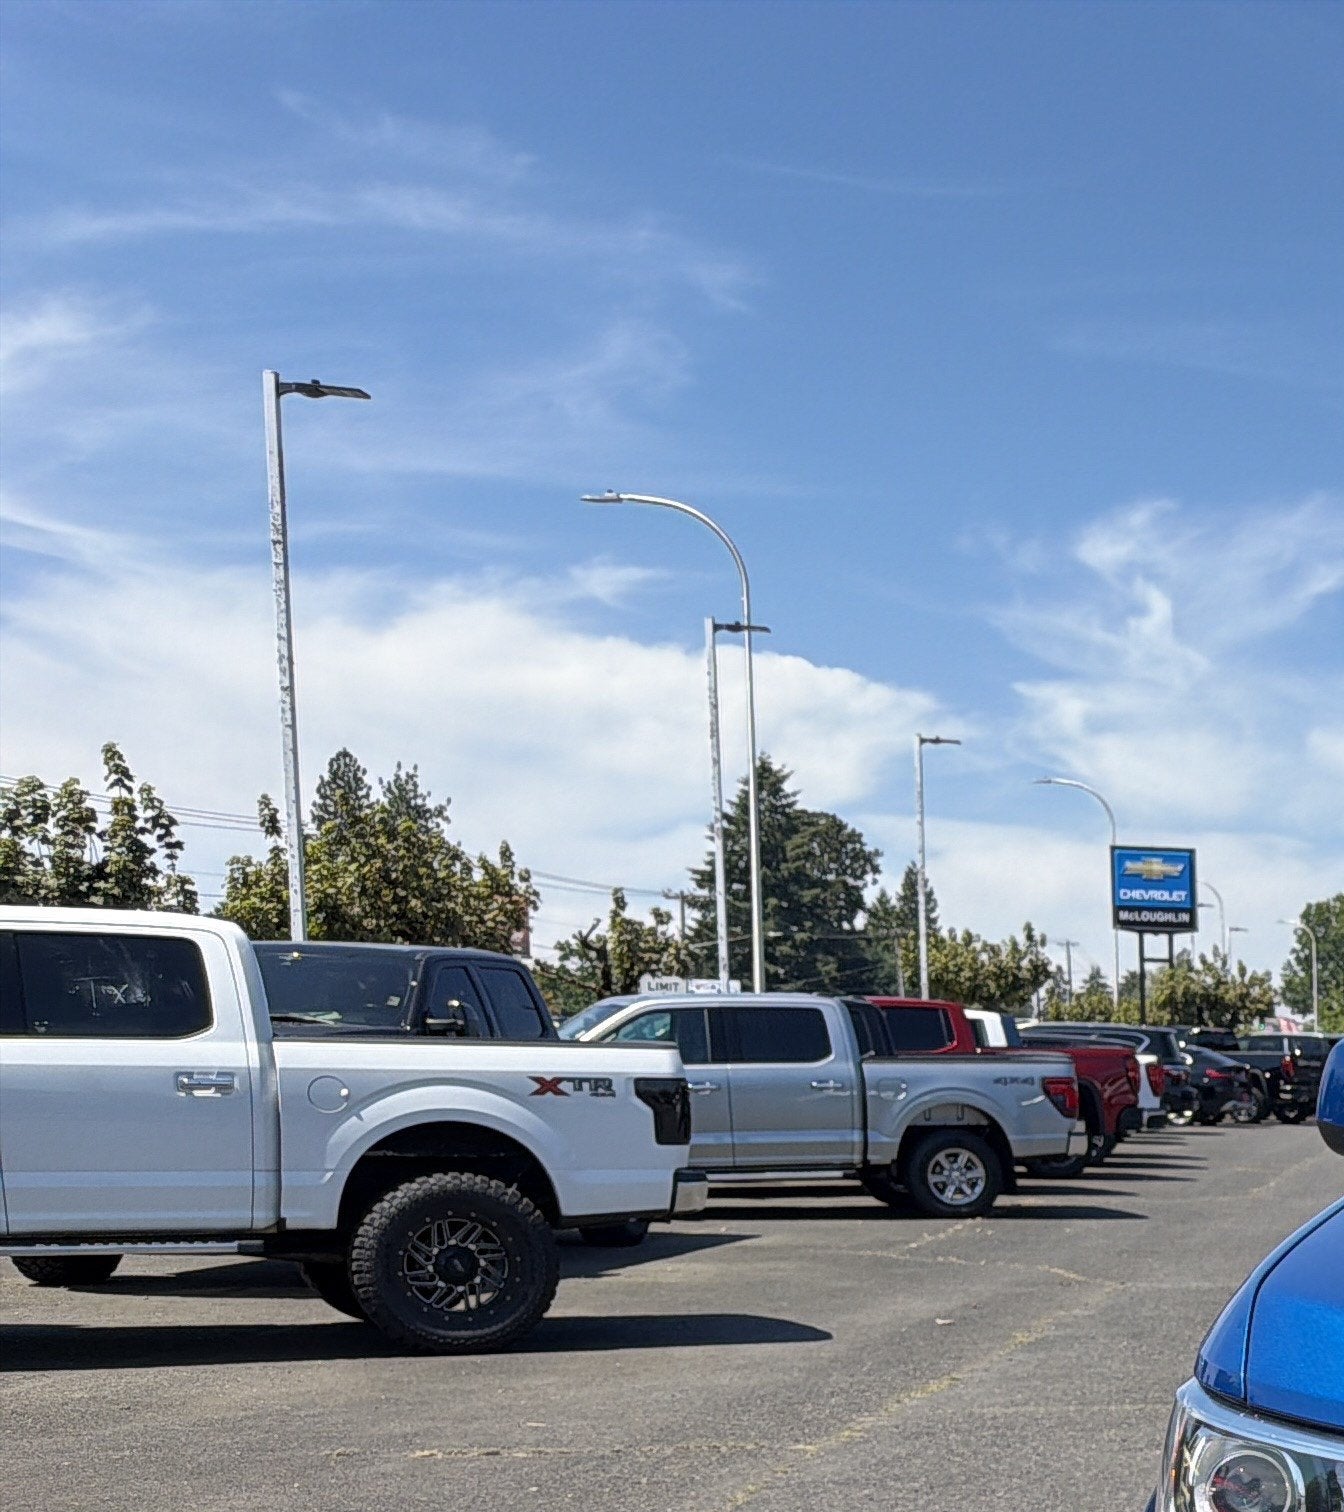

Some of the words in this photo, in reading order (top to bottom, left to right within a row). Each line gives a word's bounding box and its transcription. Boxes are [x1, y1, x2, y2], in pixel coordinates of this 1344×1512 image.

[1119, 888, 1188, 902] CHEVROLET
[647, 981, 680, 993] LIMIT
[526, 1075, 613, 1096] XTR
